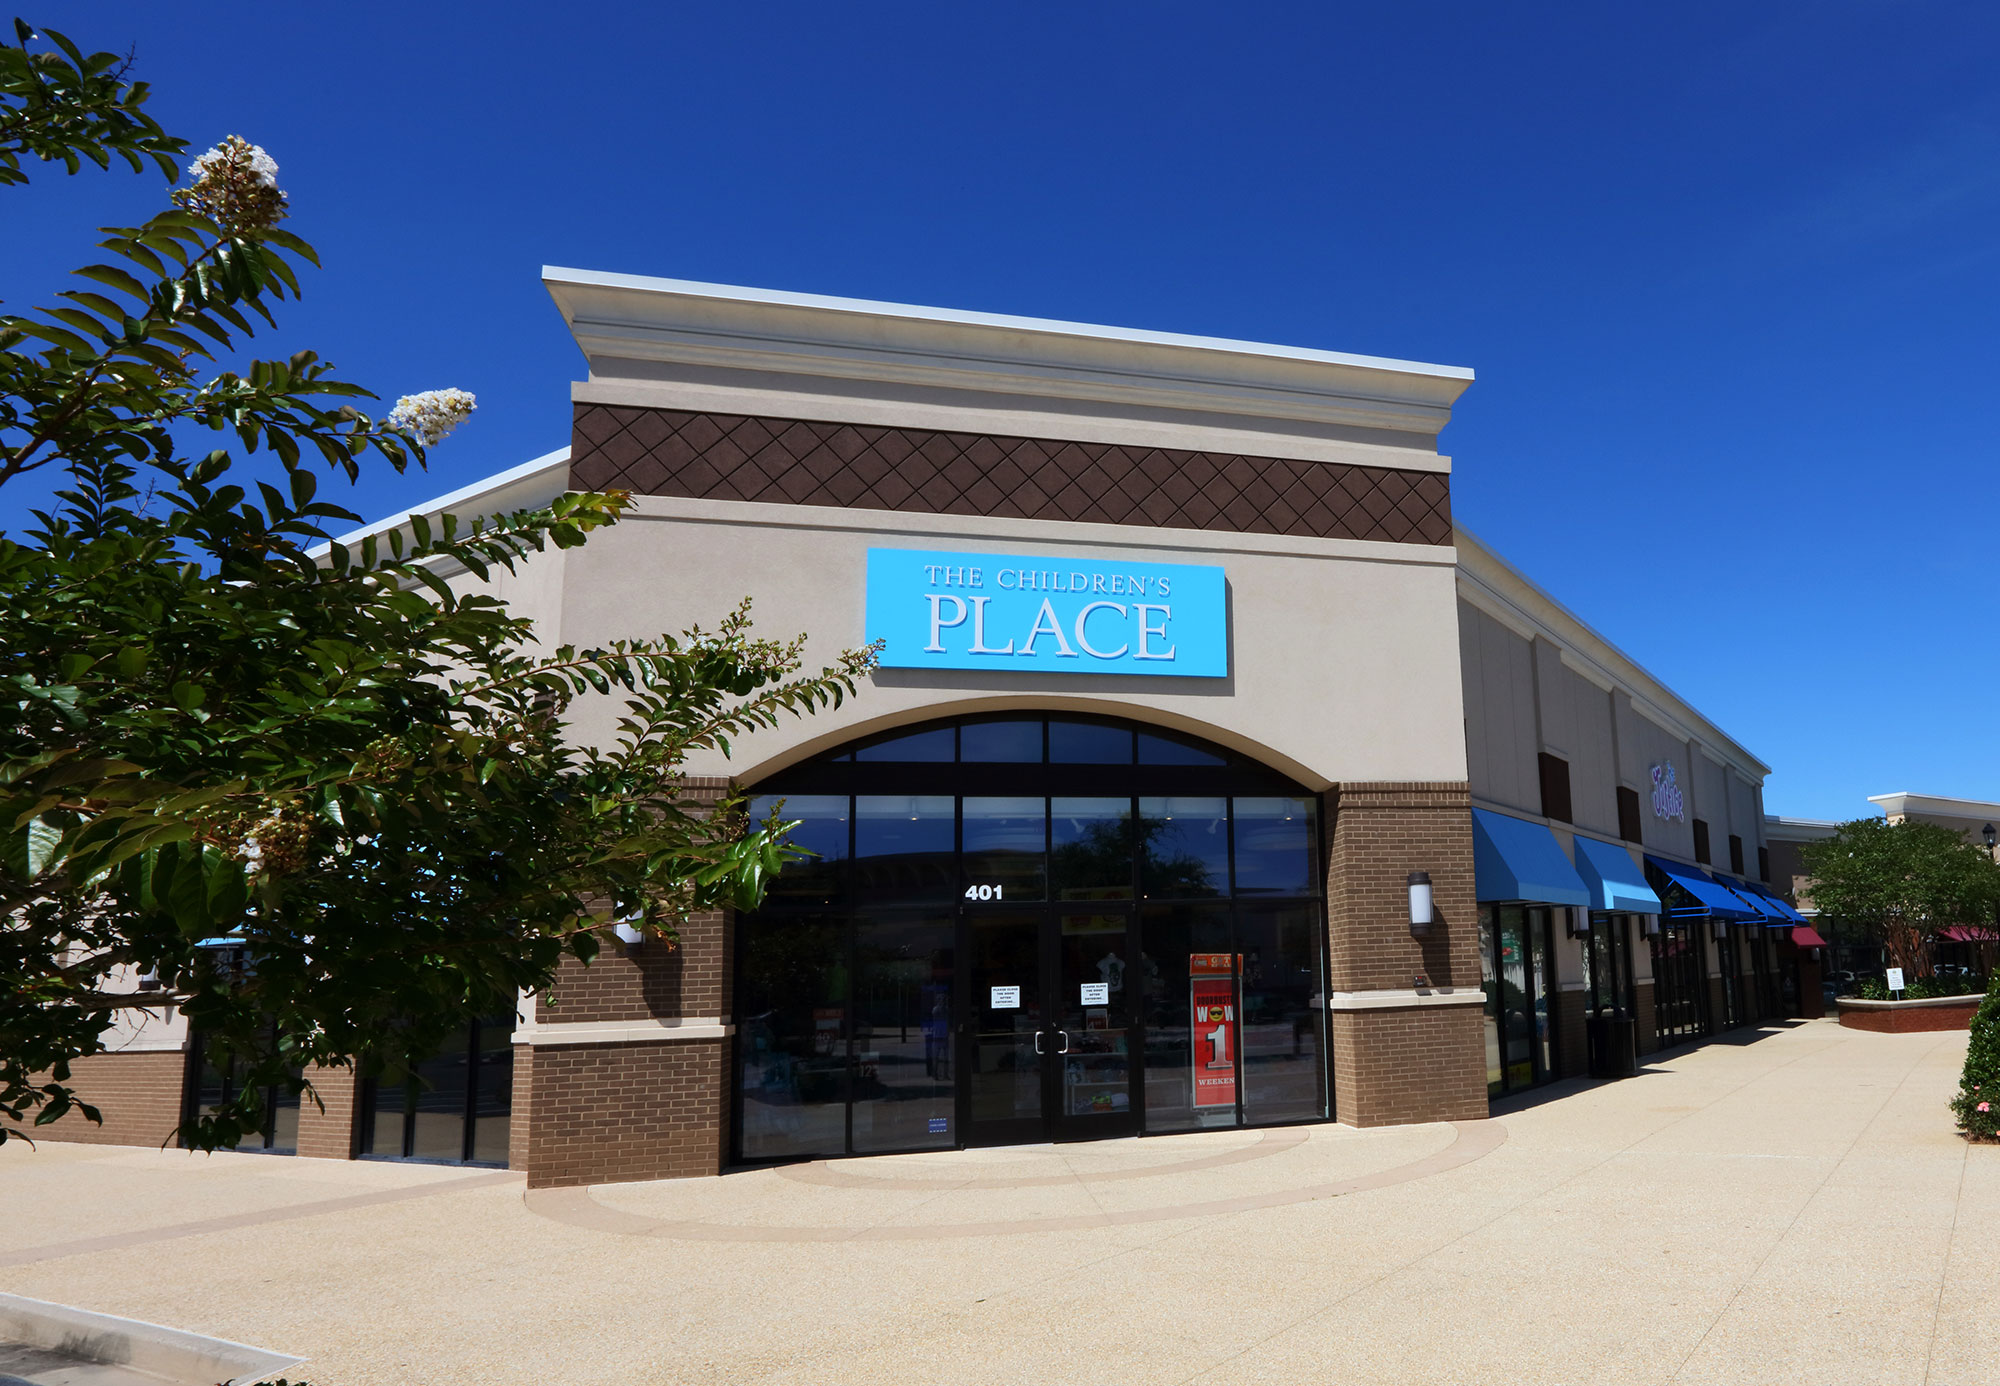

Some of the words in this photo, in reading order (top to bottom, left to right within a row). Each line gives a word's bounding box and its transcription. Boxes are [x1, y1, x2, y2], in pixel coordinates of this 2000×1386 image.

[924, 565, 983, 587] THE
[997, 568, 1170, 597] CHILDREN'S
[923, 593, 1176, 661] PLACE
[965, 884, 1003, 901] 401
[1207, 1024, 1232, 1068] 1
